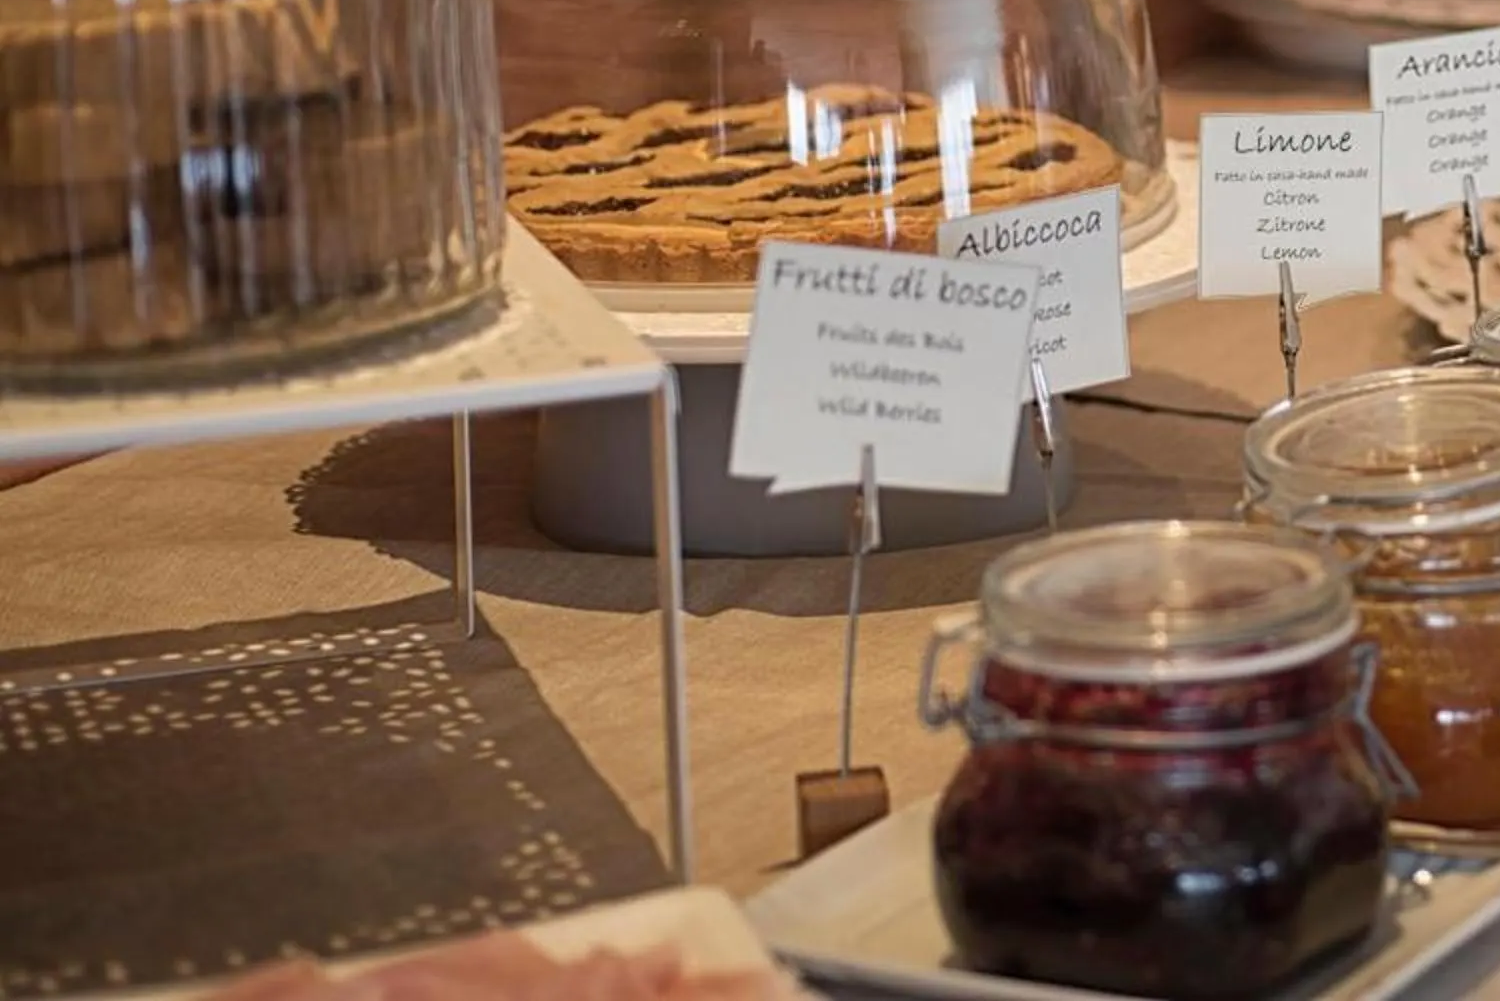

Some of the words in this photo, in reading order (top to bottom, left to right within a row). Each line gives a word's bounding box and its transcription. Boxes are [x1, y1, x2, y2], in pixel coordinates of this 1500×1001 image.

[1426, 103, 1487, 123] Orange
[1234, 125, 1353, 155] Limone
[1428, 129, 1488, 148] Orange
[1429, 154, 1489, 173] Orange
[1263, 190, 1320, 206] Citron
[957, 210, 1102, 258] Albiccoca
[1256, 217, 1327, 234] Zitrone
[1261, 247, 1323, 261] Lemon
[773, 258, 879, 297] Frutti
[889, 267, 929, 300] di
[938, 271, 1029, 311] bosco
[817, 321, 878, 344] Fruits
[884, 329, 917, 348] des
[818, 398, 869, 416] Wild
[874, 405, 942, 424] Berries
